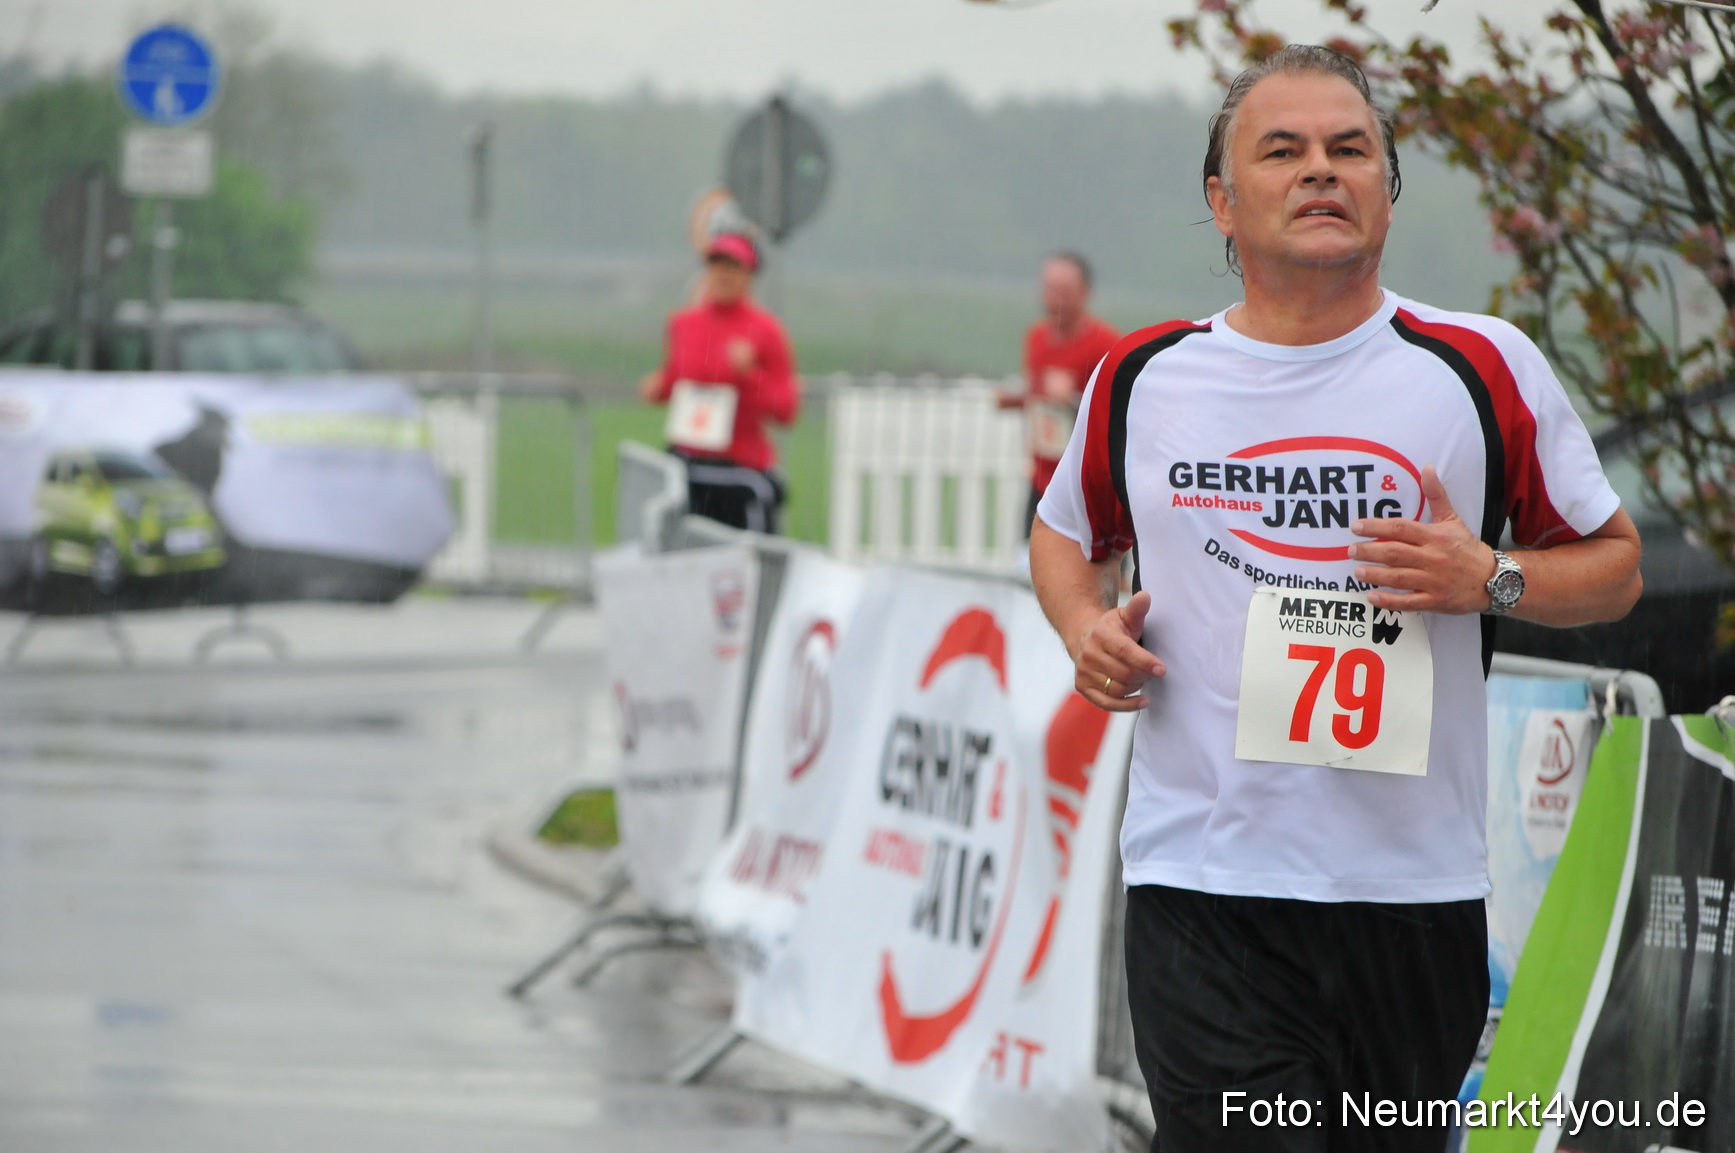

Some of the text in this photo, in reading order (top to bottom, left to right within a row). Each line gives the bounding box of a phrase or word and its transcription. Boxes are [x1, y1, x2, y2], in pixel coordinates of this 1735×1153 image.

[1168, 462, 1398, 495] GERHART &
[1171, 493, 1403, 529] Autohaus JÄNIG
[1204, 538, 1240, 569] Das
[1244, 563, 1339, 592] sportliche
[1279, 597, 1366, 622] MEYER
[1279, 617, 1366, 638] WERBUNG
[1287, 643, 1386, 749] 79
